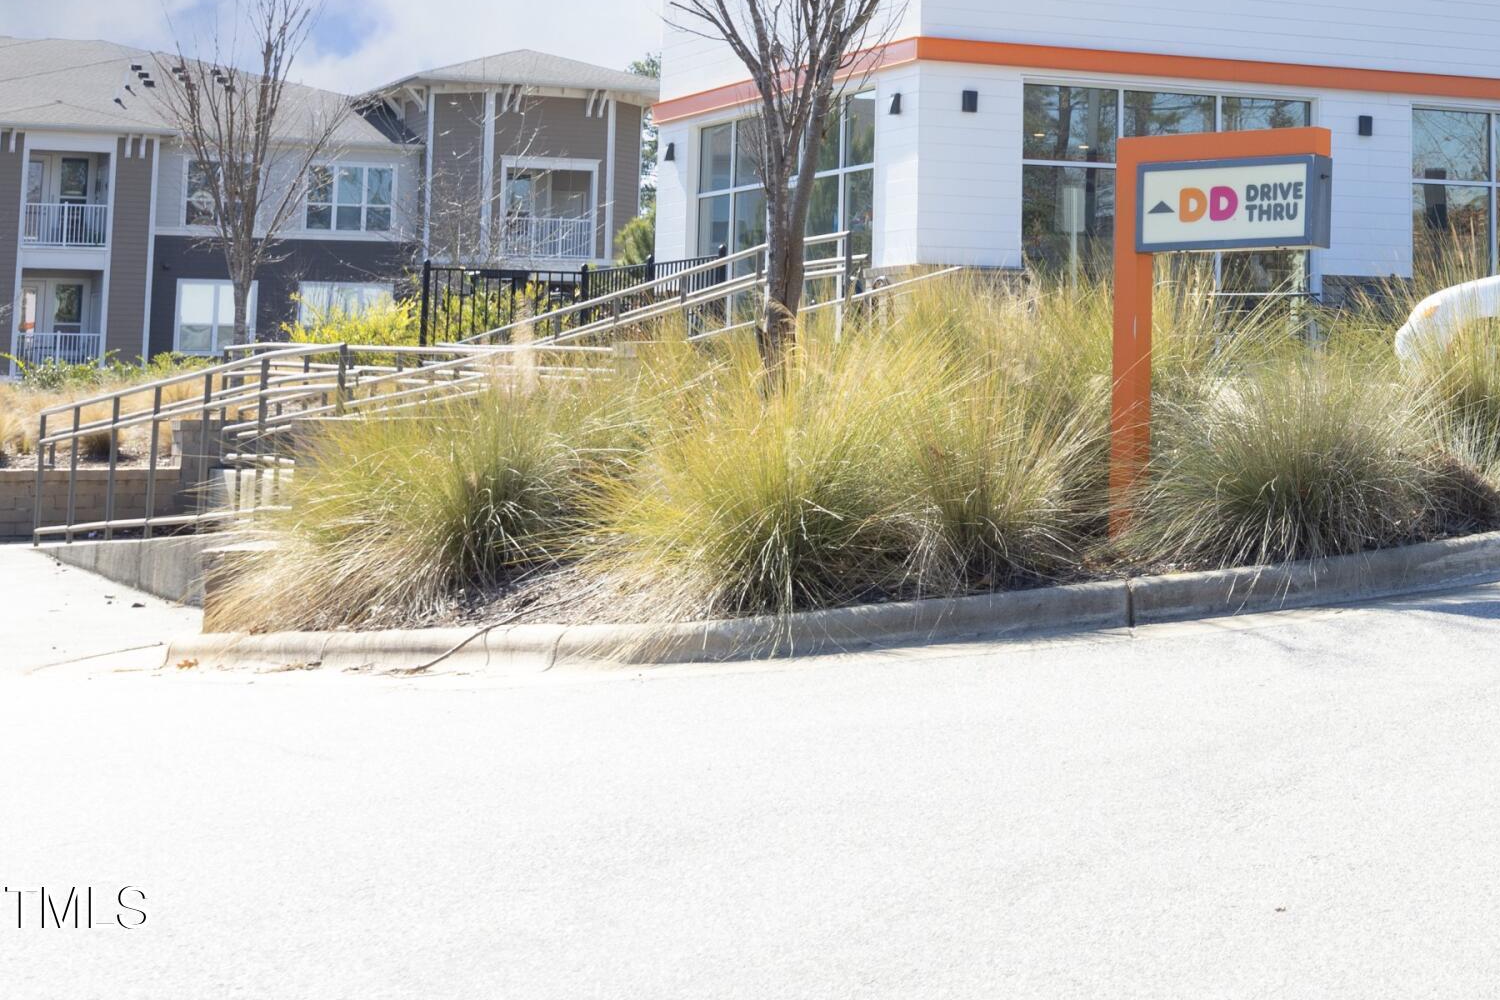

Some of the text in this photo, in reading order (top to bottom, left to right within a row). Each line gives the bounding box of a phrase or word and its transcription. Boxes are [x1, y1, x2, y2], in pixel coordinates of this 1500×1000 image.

[1245, 181, 1304, 202] DRIVE
[1179, 186, 1239, 223] DD
[1245, 202, 1298, 222] THRU
